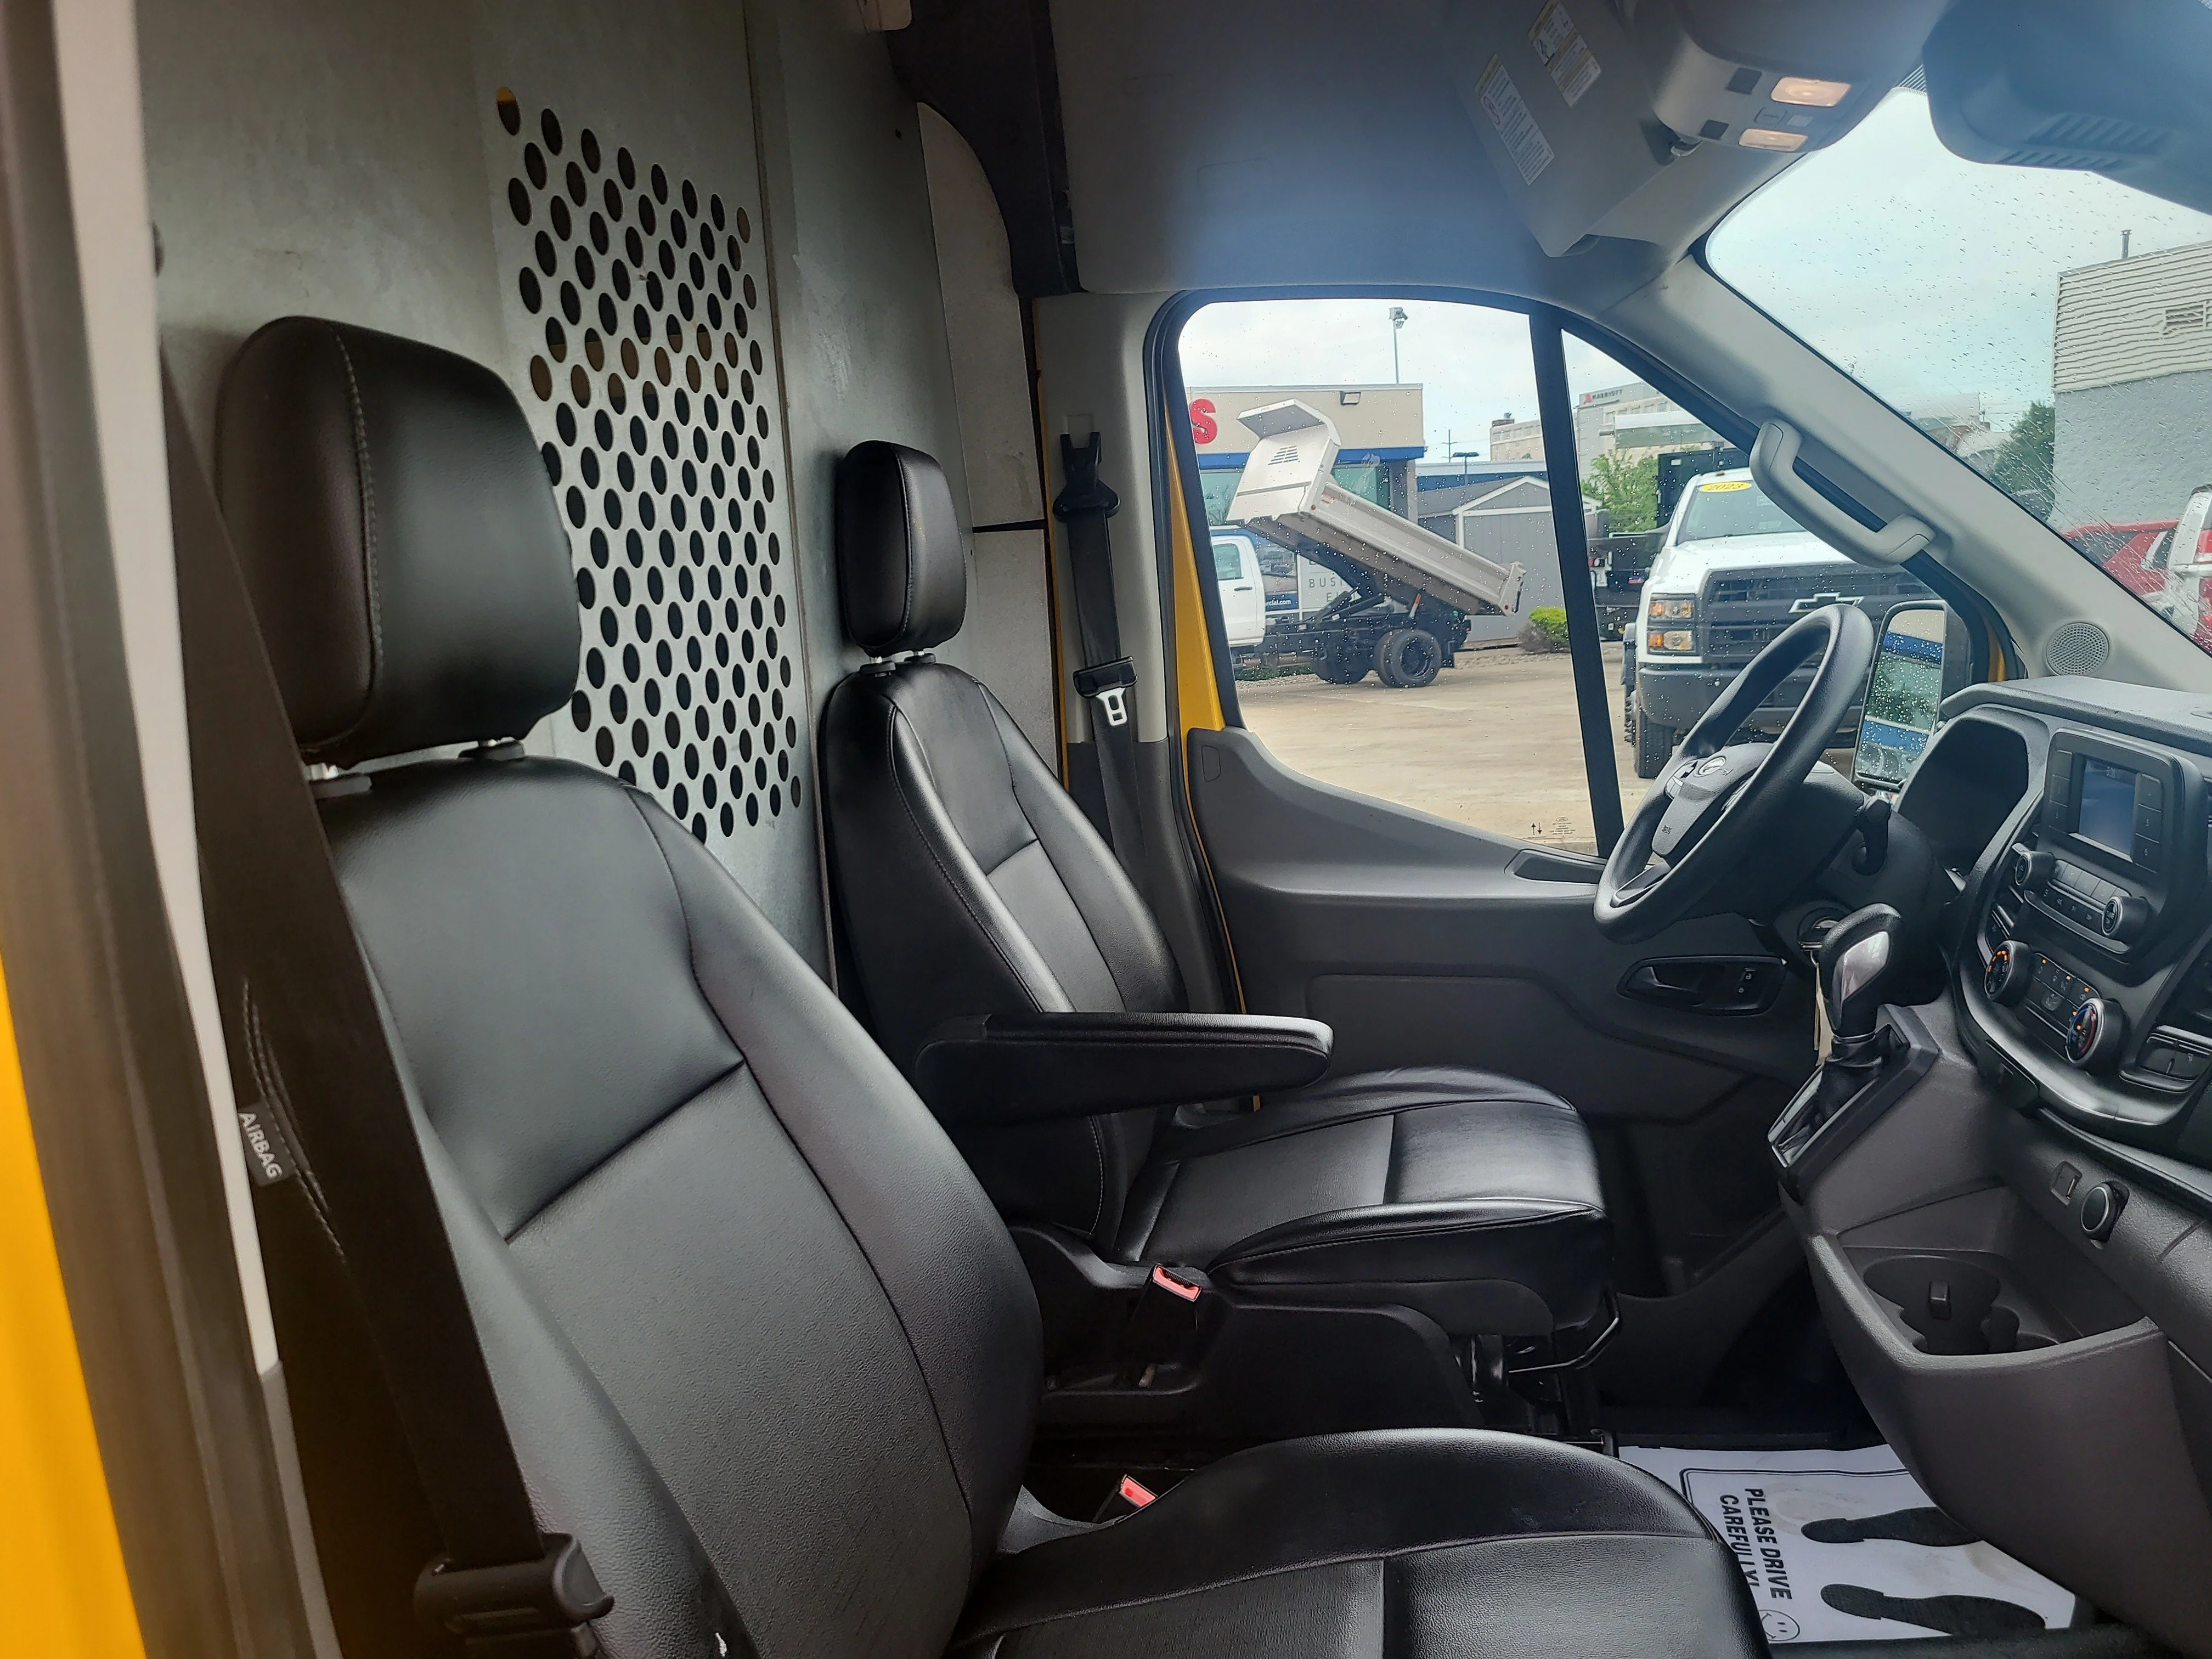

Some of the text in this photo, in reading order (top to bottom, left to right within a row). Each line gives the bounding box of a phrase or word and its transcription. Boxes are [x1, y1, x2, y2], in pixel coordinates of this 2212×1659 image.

[1189, 399, 1217, 444] S
[238, 1113, 283, 1178] AIRBAG
[1745, 1488, 1792, 1600] PLEASE DRIVE
